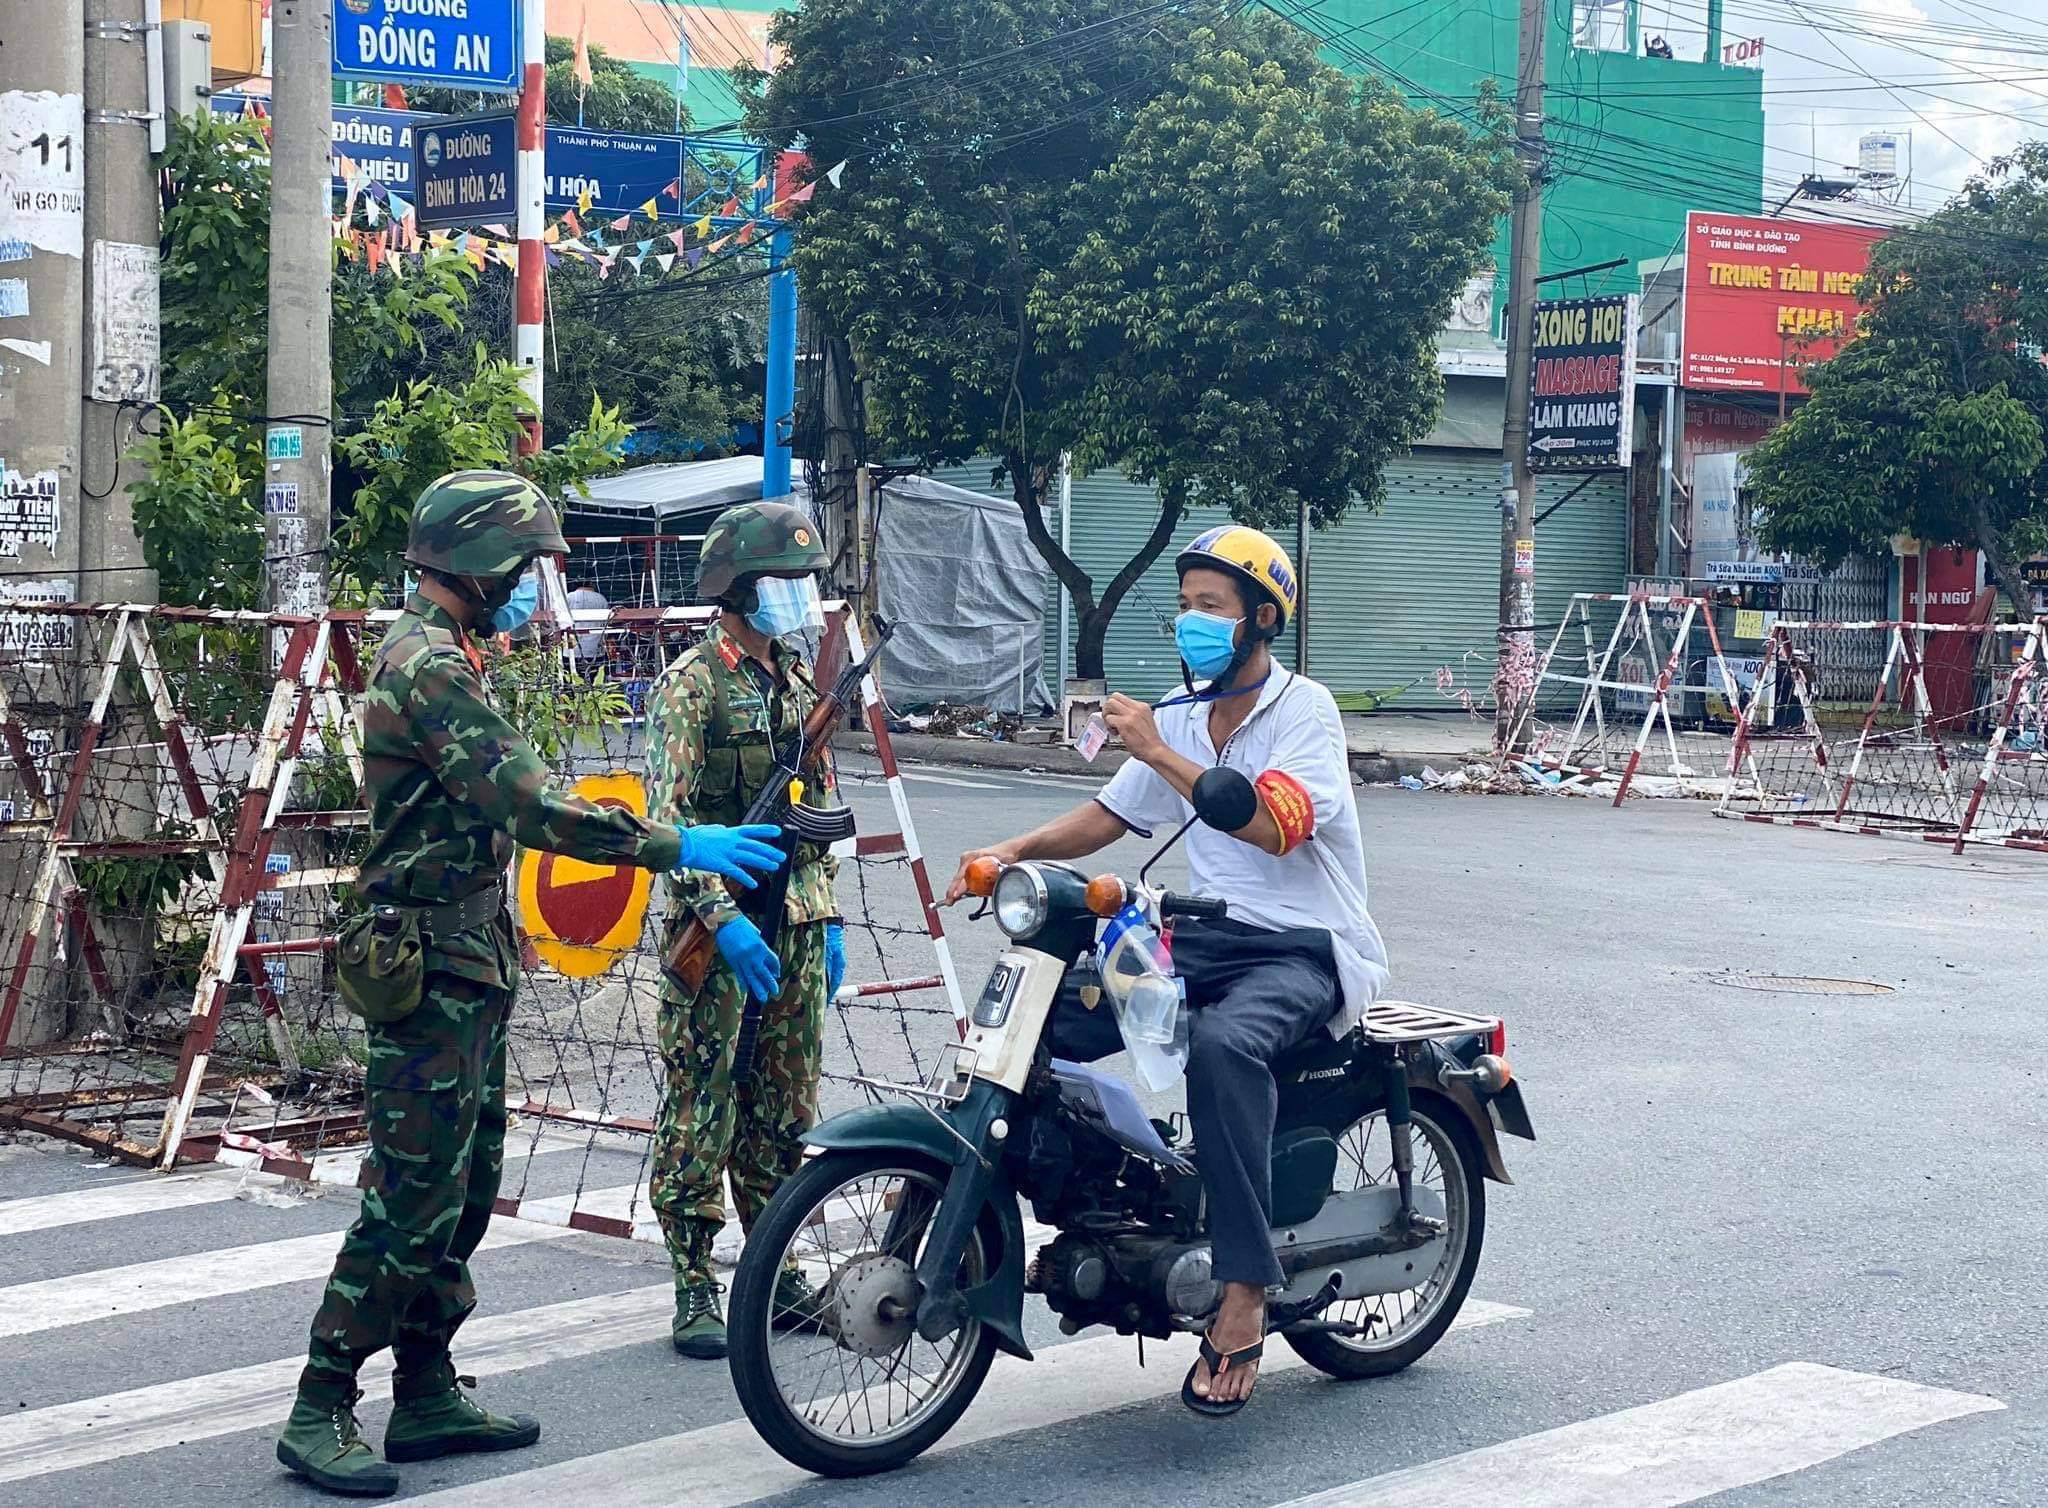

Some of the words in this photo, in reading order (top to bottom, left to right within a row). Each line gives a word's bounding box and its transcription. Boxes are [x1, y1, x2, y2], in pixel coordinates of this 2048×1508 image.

[358, 13, 436, 69] ĐỒNG
[454, 34, 491, 73] AN
[331, 115, 393, 147] ĐỒNG
[446, 130, 492, 160] ĐƯỜNG
[644, 143, 657, 153] AN
[425, 172, 455, 208] BÌNH
[459, 167, 486, 205] HÒA
[489, 172, 506, 202] 24
[560, 174, 602, 200] HÓA
[1696, 223, 1710, 235] SỞ
[1711, 225, 1732, 237] GIÁO
[1754, 230, 1762, 239] &
[1733, 240, 1755, 252] BÌNH
[1707, 262, 1772, 290] TRUNG
[1778, 262, 1818, 293] TÂM
[1591, 304, 1623, 344] HƠI
[1535, 354, 1620, 397] MASSAGE
[1567, 402, 1617, 427] KHANG
[1308, 1067, 1346, 1080] HONDA
